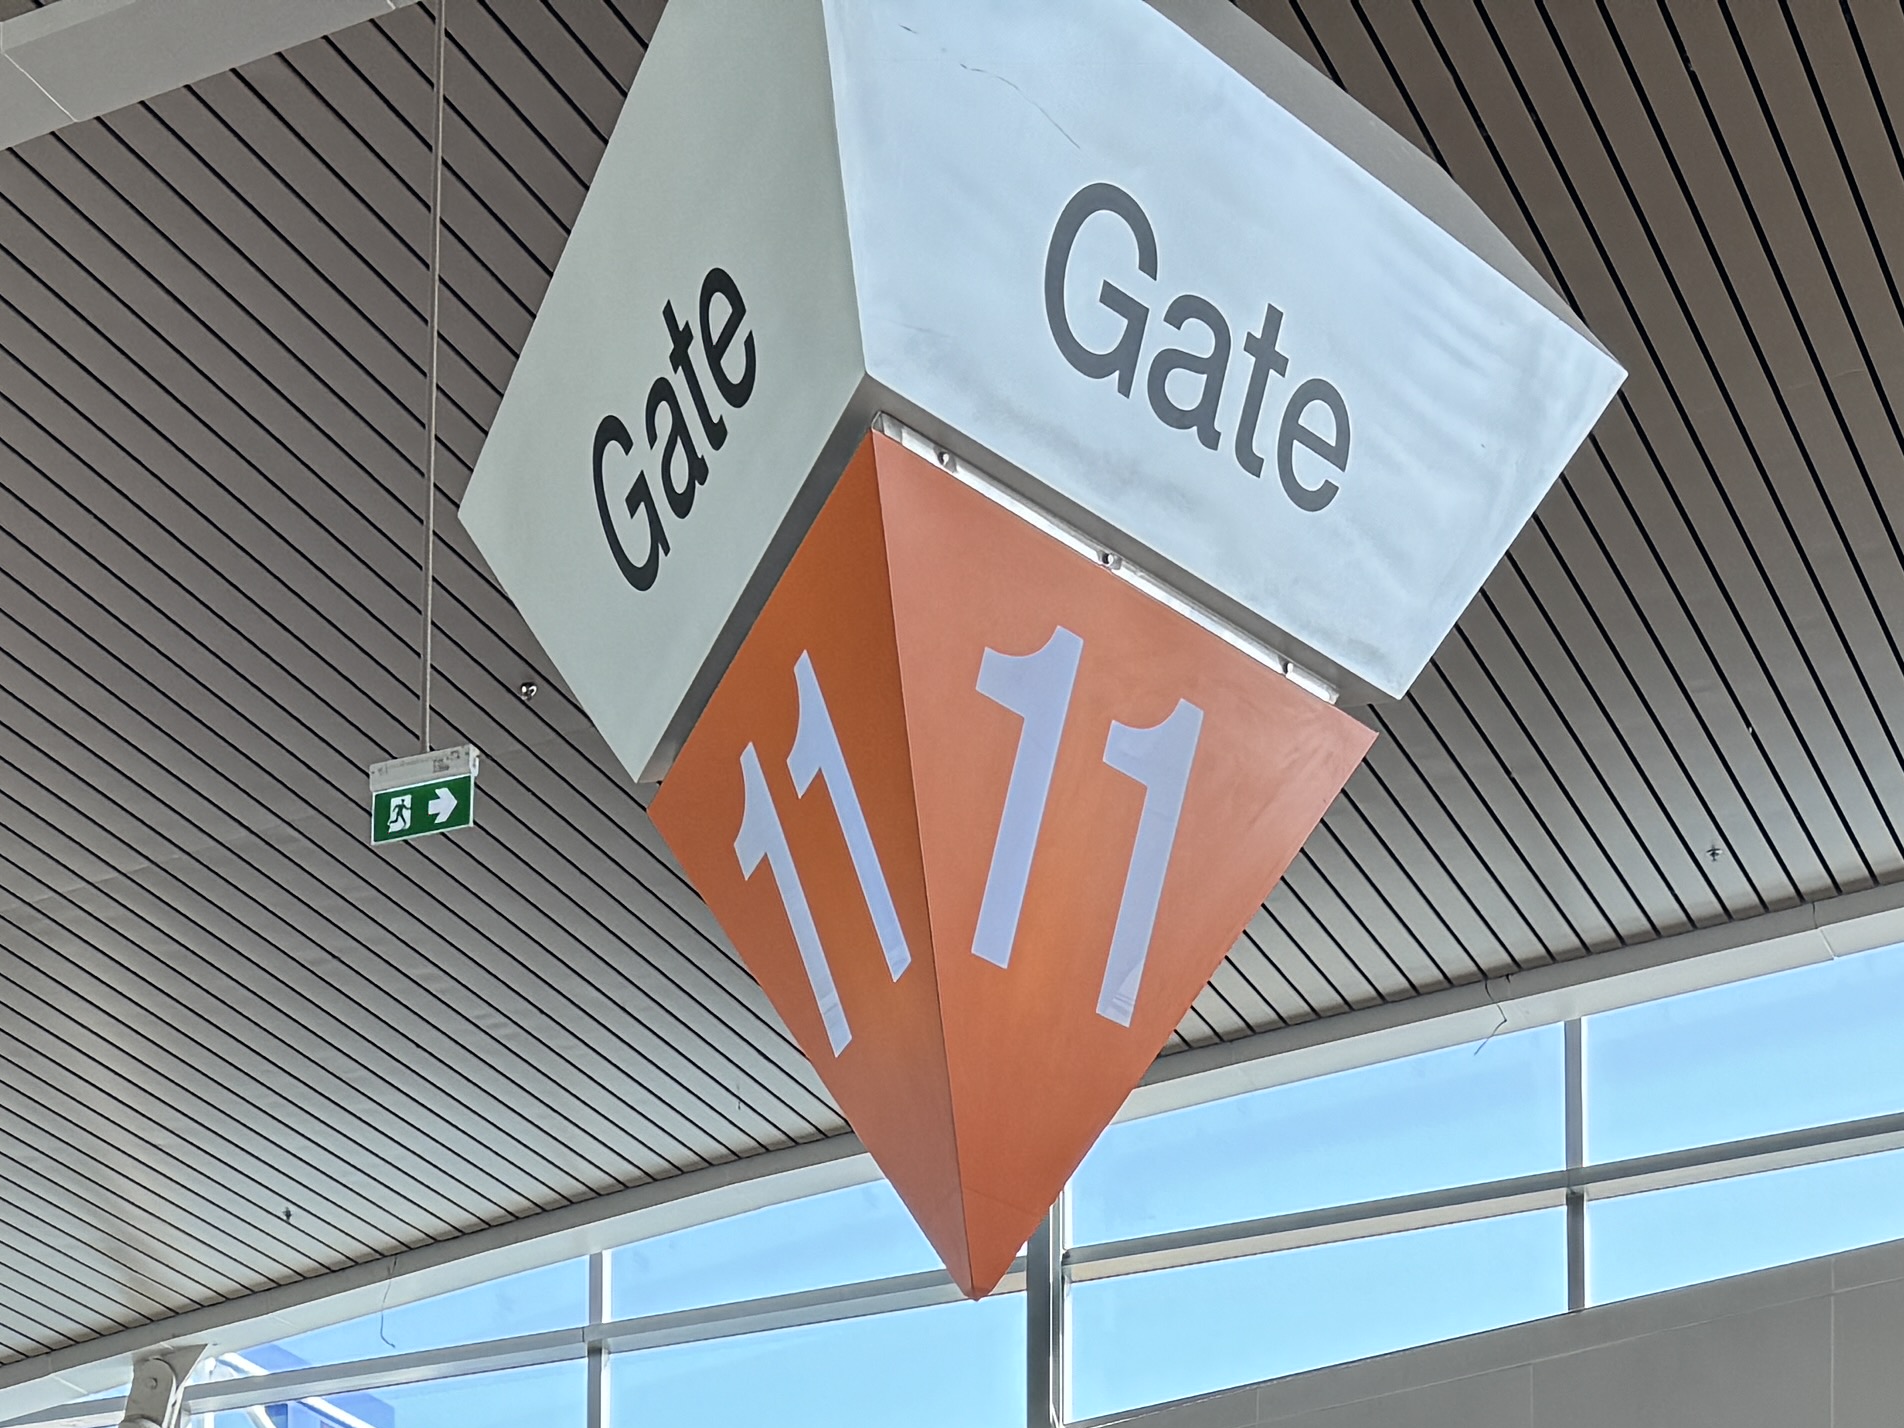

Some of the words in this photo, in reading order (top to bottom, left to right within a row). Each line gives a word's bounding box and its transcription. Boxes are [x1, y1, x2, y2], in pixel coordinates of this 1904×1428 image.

[592, 267, 757, 591] Gate
[1044, 183, 1352, 512] Gate
[733, 650, 912, 1057] 11
[971, 625, 1204, 1028] 11
